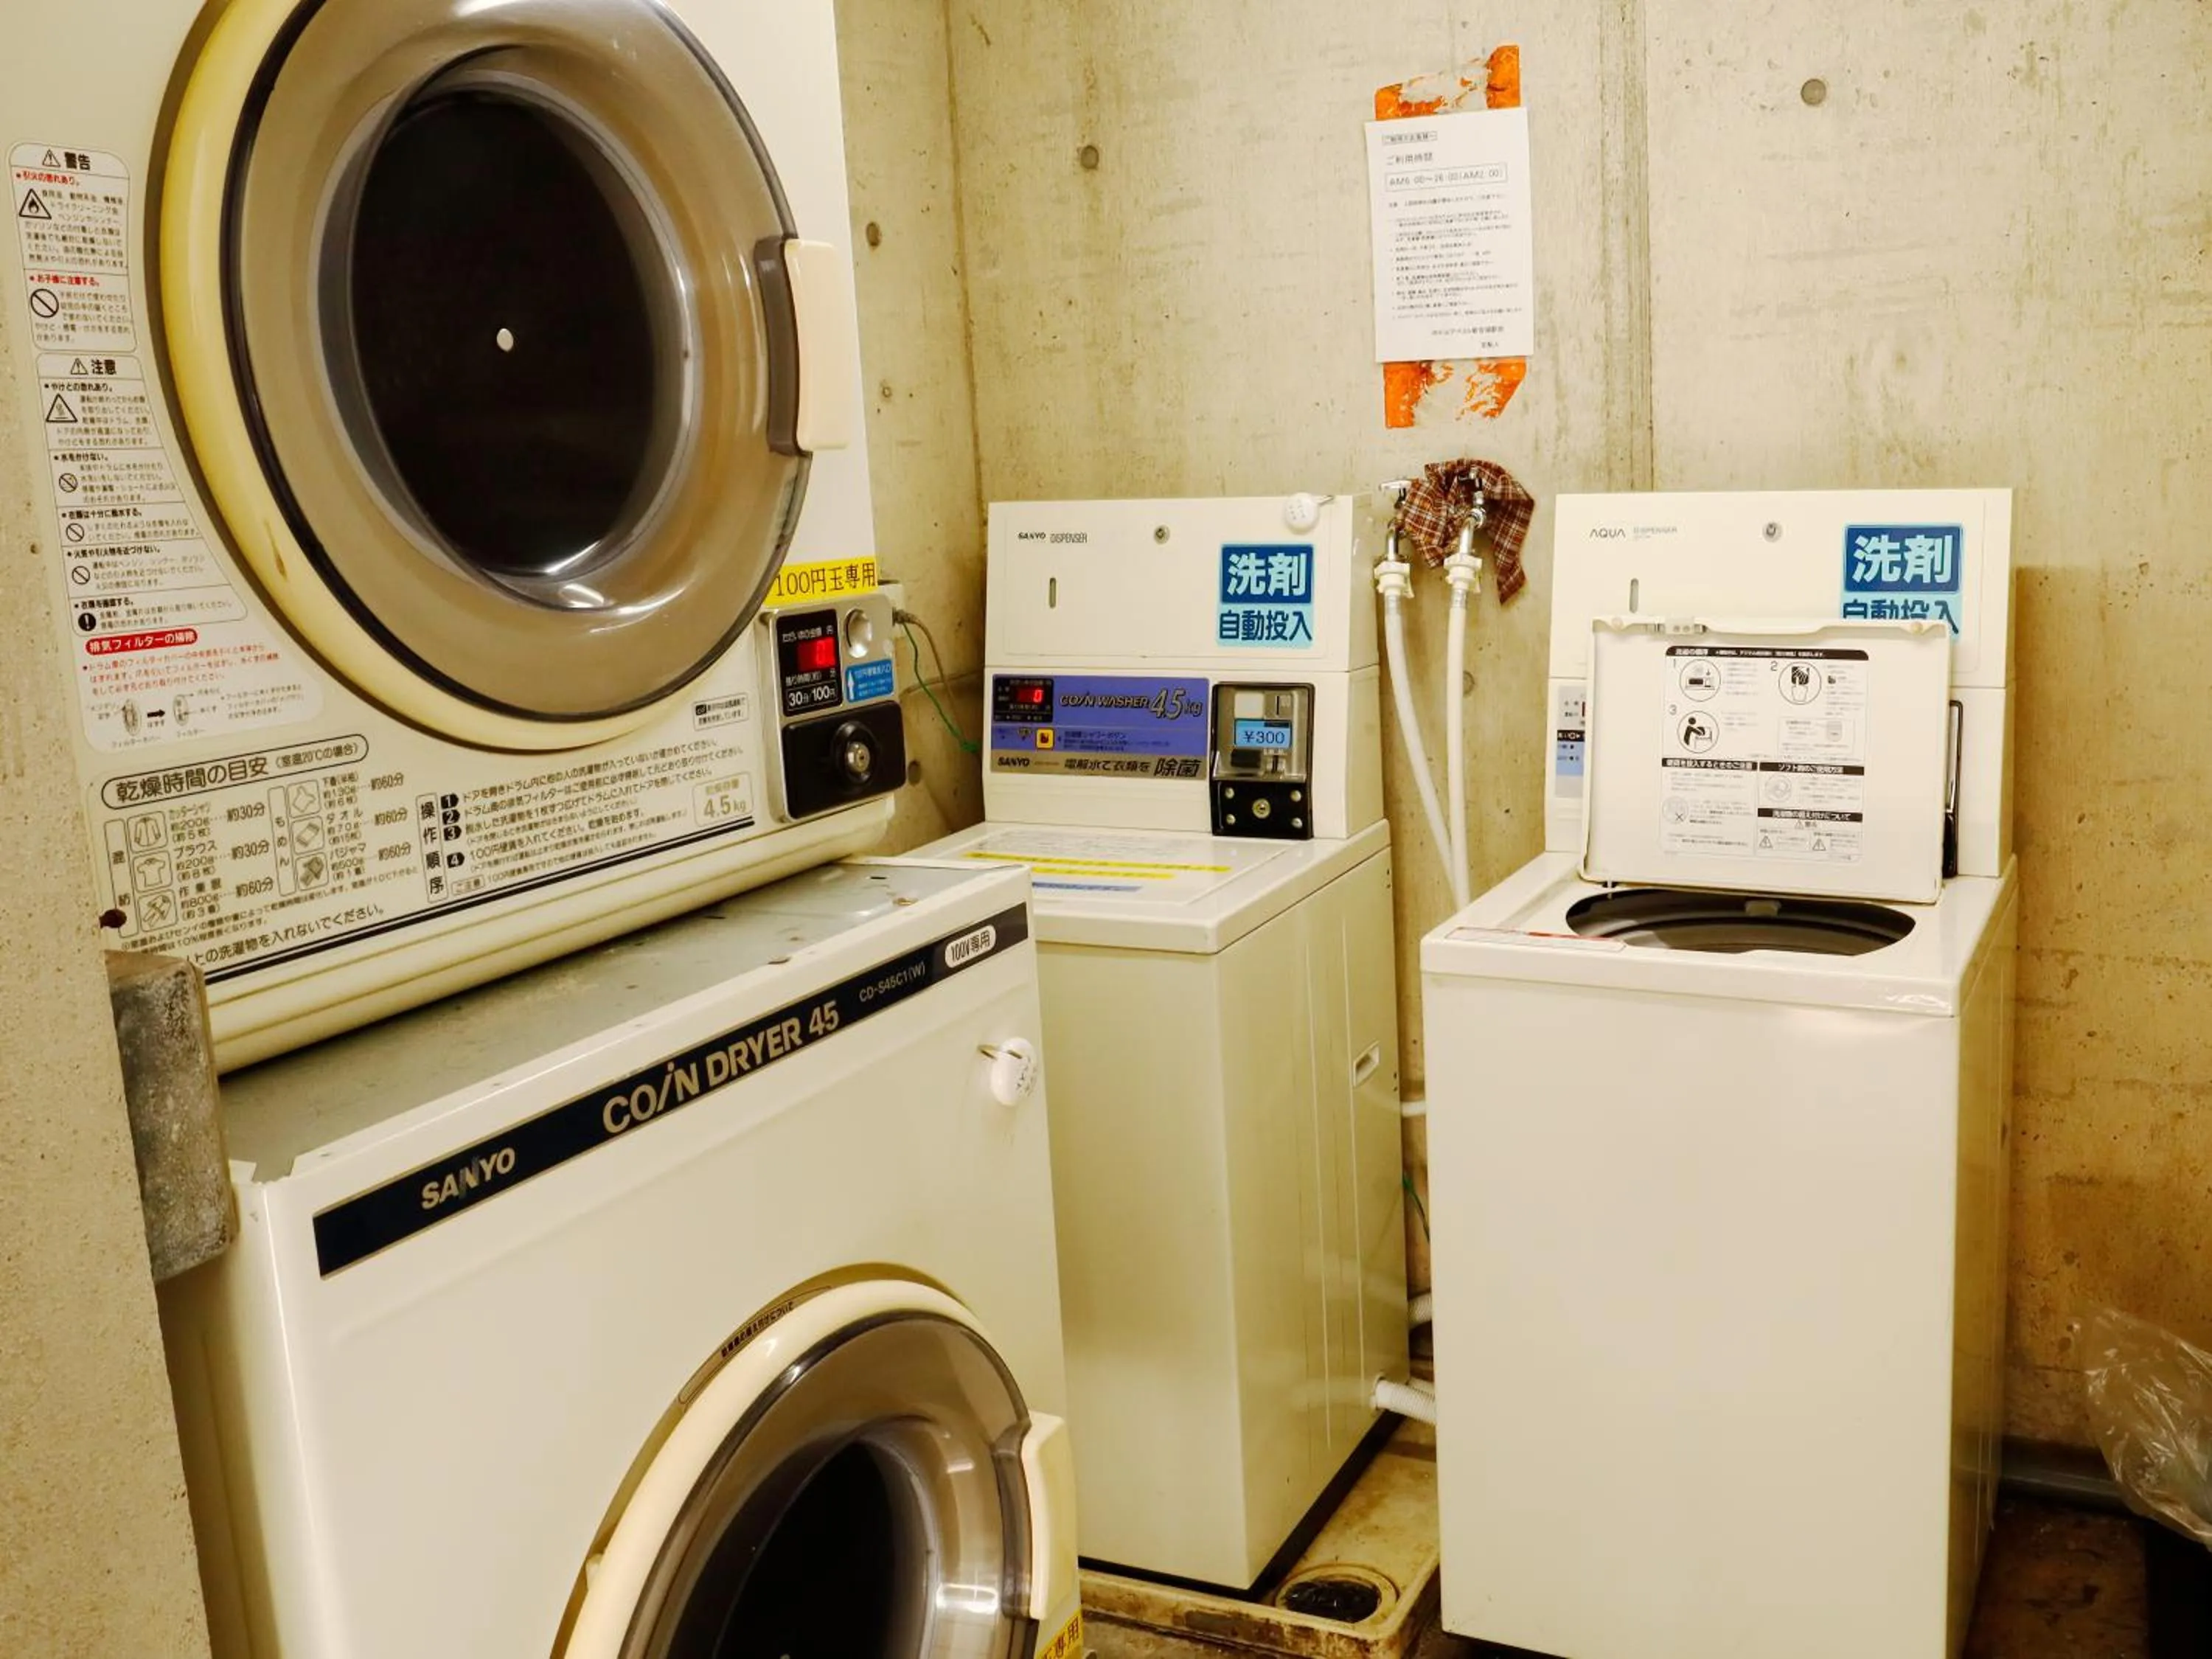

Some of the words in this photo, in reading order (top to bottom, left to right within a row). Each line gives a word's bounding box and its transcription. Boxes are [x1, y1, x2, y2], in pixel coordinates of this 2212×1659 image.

[64, 151, 91, 171] 警告
[91, 359, 117, 375] 注意
[1018, 532, 1046, 540] SANYO
[1050, 532, 1088, 543] DISPENSER
[1590, 528, 1627, 538] AQUA
[1851, 534, 1954, 584] 洗剤
[774, 562, 876, 597] 100円玉専用
[1227, 552, 1307, 597] 洗剤
[1220, 609, 1312, 642] 自動投入
[89, 630, 195, 653] 排気フィルターの掃除
[1770, 661, 1779, 672] 2
[1096, 695, 1150, 709] WASHER
[1242, 730, 1285, 744] ¥300
[997, 757, 1030, 767] SANYO
[116, 757, 269, 803] 乾燥時間の目安
[226, 803, 266, 824] 約30分
[173, 840, 218, 858] ブラウス
[232, 840, 270, 860] 約30分
[420, 800, 445, 894] 操作順序
[421, 1146, 516, 1211] SANYO
[706, 1019, 802, 1088] DRYER
